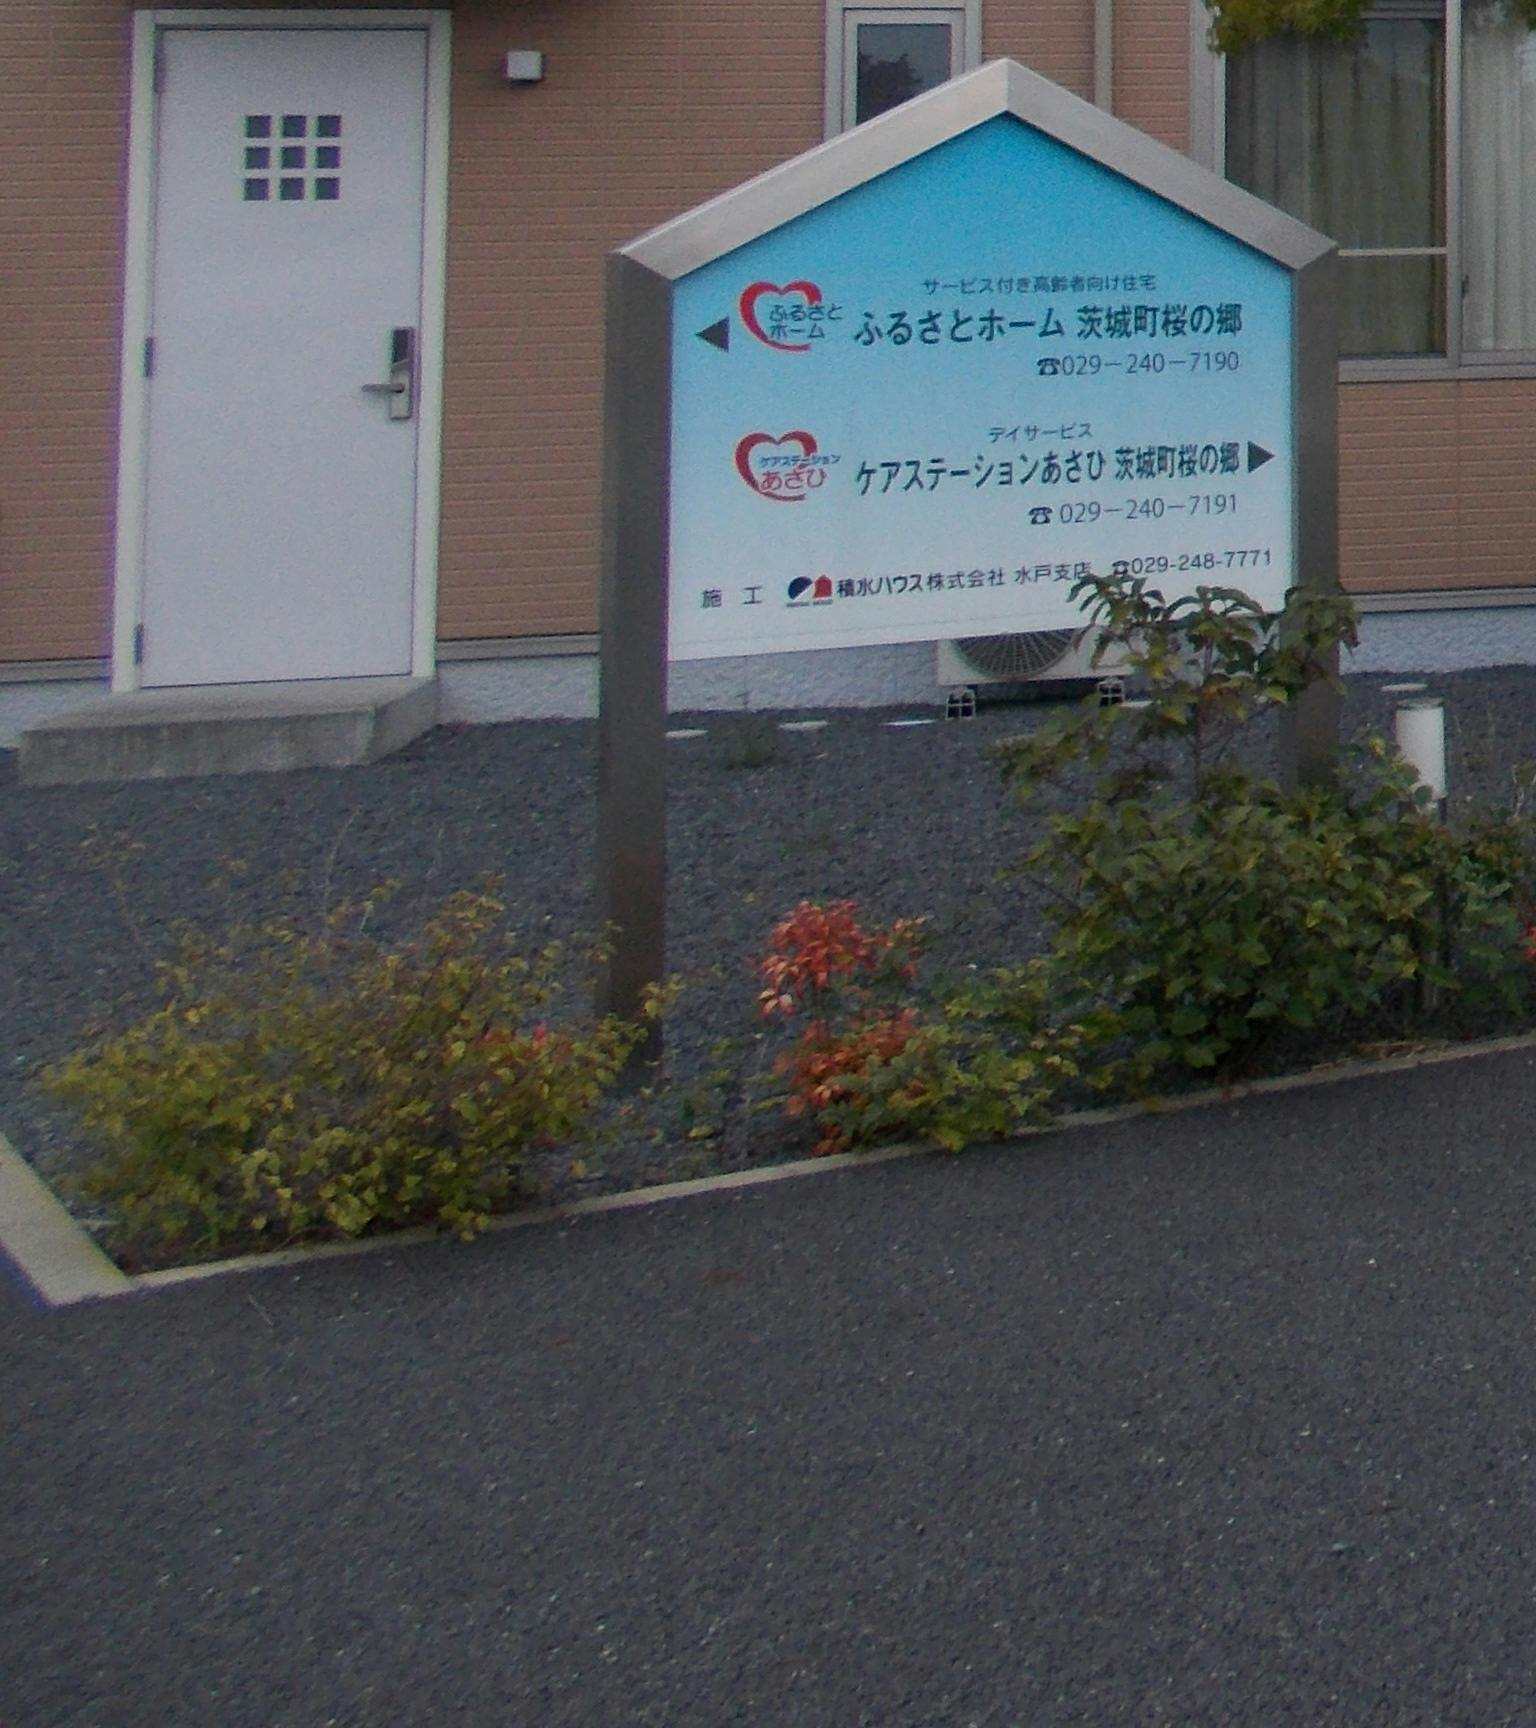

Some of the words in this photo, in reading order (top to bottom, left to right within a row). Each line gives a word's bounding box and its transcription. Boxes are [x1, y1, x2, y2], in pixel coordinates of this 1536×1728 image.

[923, 274, 1157, 296] サービス付き高齢者向け住宅
[769, 303, 843, 322] ふるさと
[854, 307, 1065, 346] ふるさとホーム
[1076, 302, 1243, 340] 茨城町桜の郷
[769, 323, 825, 340] ホーム
[989, 422, 1094, 444] デイサービス
[760, 468, 828, 492] あさひ
[855, 447, 1107, 497] ケアステーションあさひ
[1114, 440, 1241, 481] 茨城町桜の郷
[837, 566, 1005, 599] 積水ハウス株式会社
[1130, 549, 1272, 575] 029-248-7771
